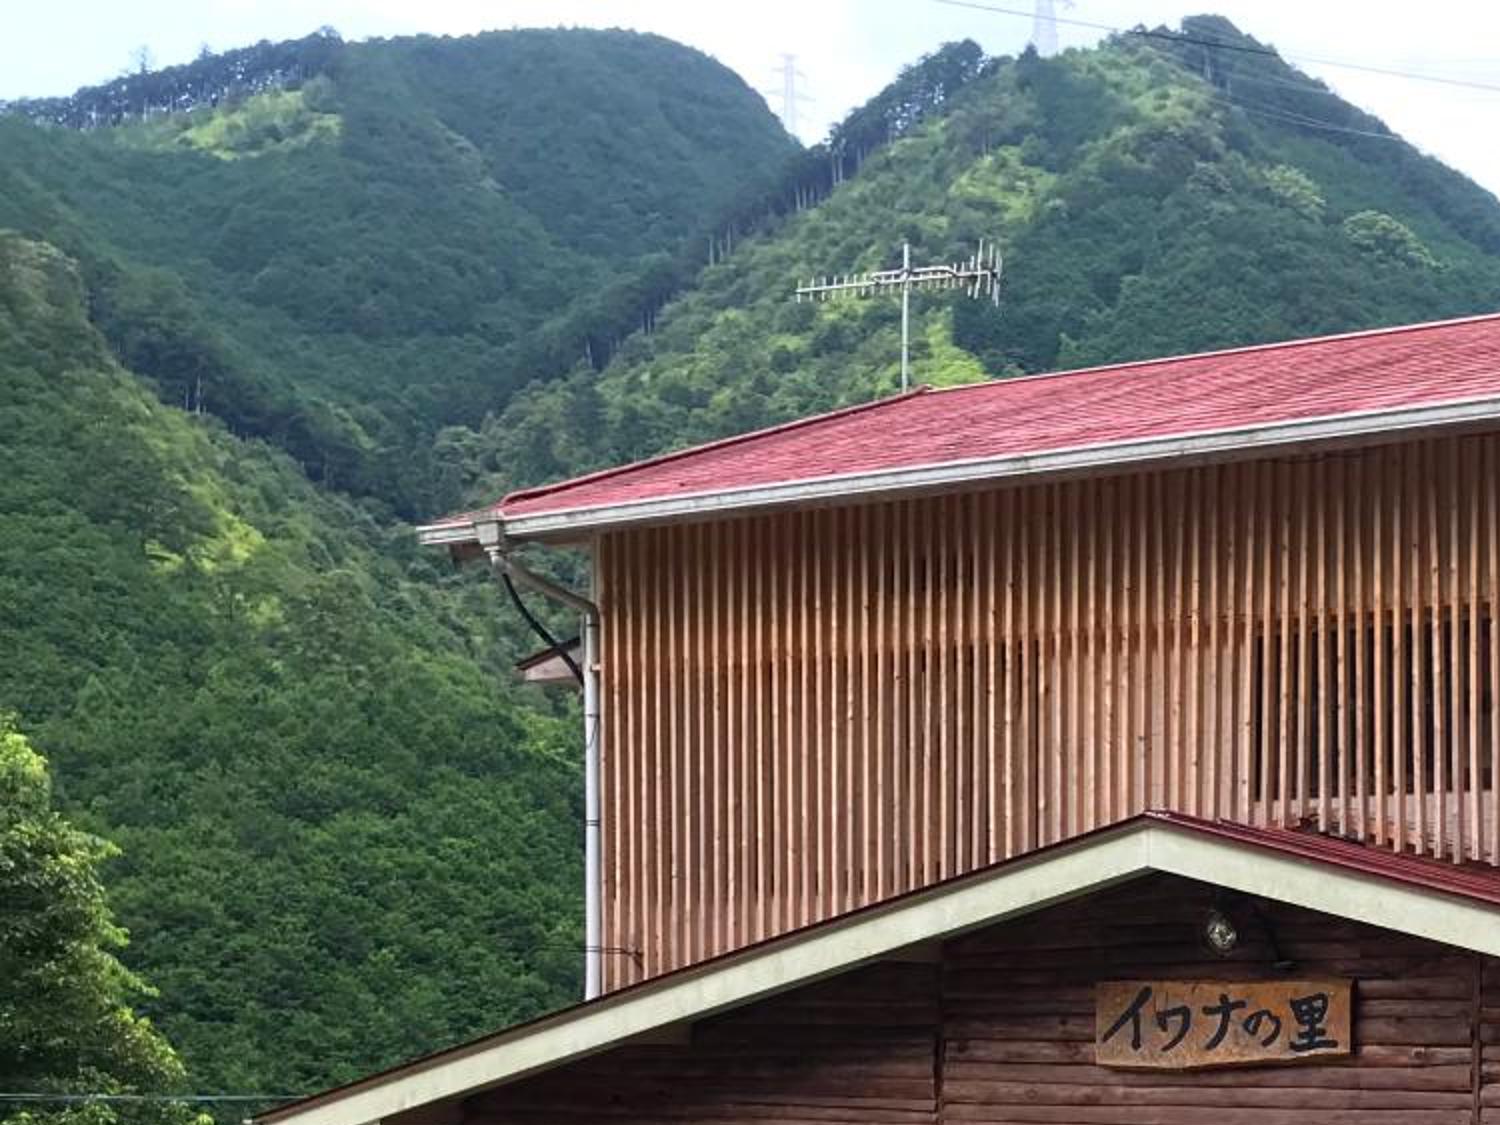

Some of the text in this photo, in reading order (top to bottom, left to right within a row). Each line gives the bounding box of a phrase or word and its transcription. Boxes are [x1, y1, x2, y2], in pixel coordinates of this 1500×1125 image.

[1102, 986, 1338, 1051] イワナの里
